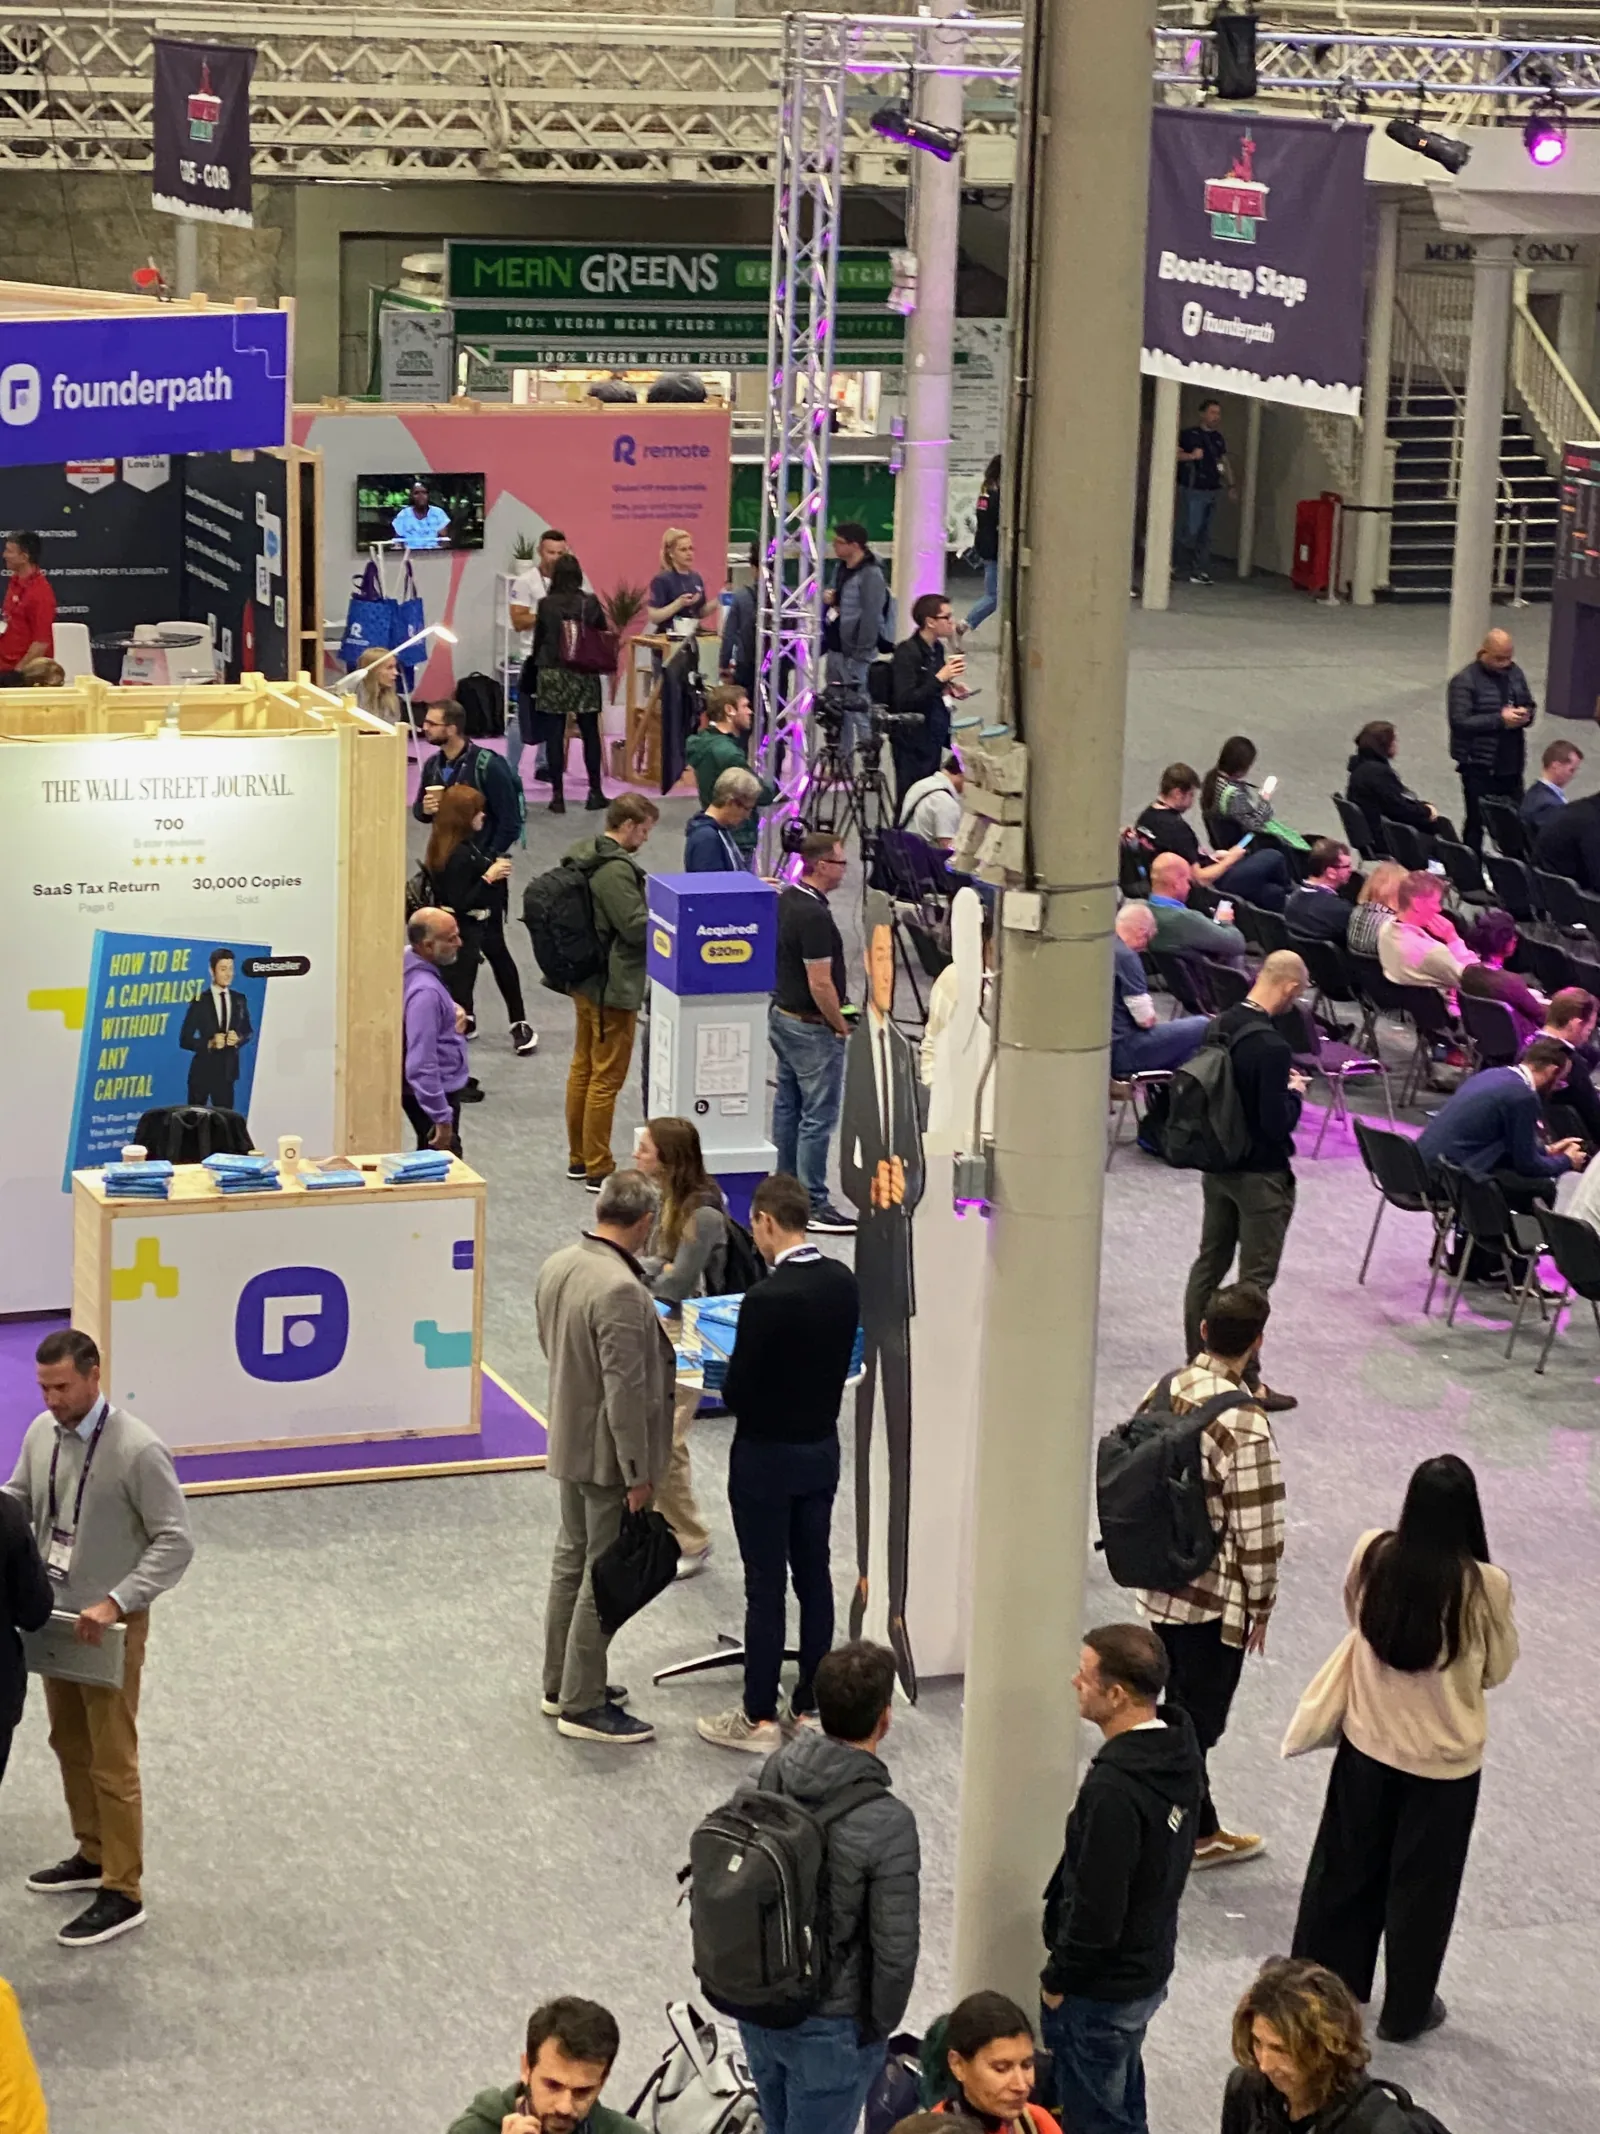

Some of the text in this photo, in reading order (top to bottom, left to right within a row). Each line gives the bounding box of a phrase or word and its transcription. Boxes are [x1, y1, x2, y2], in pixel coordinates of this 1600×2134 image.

[1527, 243, 1580, 261] ONLY
[474, 257, 572, 287] MEAN
[579, 252, 719, 292] GREENS
[1158, 251, 1308, 307] Bootstrap Stage
[613, 318, 658, 331] MEAN
[536, 351, 750, 364] 100% VEGAN MEAN FEEDS
[52, 366, 233, 411] founderpath
[643, 444, 710, 458] remote
[42, 780, 81, 804] THE
[86, 778, 135, 802] WALL
[138, 775, 209, 801] STREET
[154, 818, 184, 831] 700
[32, 880, 161, 897] SaaS Tax Return
[192, 875, 303, 892] 30,000 Copies
[78, 901, 115, 915] Page 6
[235, 894, 260, 906] Sold
[696, 922, 759, 938] Acquired!
[708, 946, 744, 957] $20m
[108, 948, 192, 977] HOW TO BE
[252, 960, 302, 974] Bestseller
[104, 978, 206, 1009] A CAPITALIST
[101, 1012, 170, 1041] WITHOUT
[97, 1046, 130, 1072] ANY
[94, 1075, 154, 1102] CAPITAL
